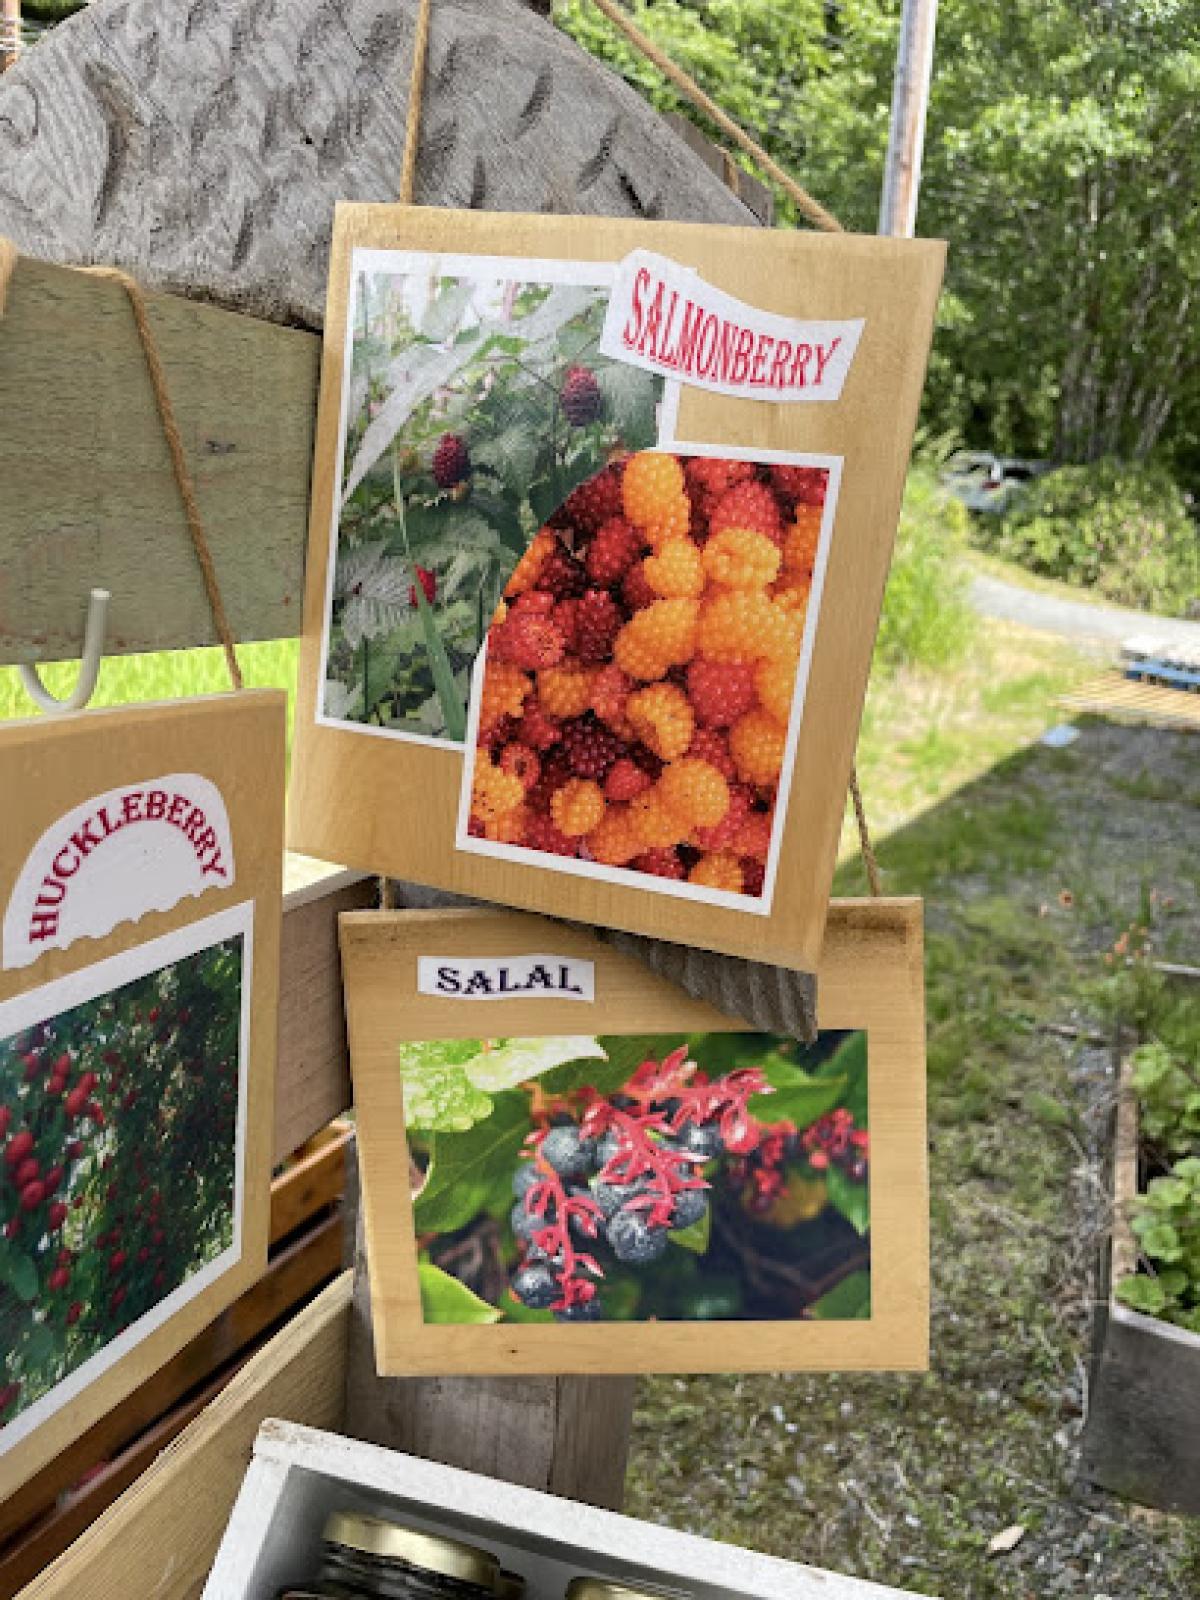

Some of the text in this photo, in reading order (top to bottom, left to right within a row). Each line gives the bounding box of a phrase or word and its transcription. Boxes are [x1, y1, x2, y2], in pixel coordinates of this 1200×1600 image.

[623, 267, 842, 390] SALMONBERRY
[29, 790, 228, 943] HUCKLEBERRY
[437, 964, 583, 994] SALAL
